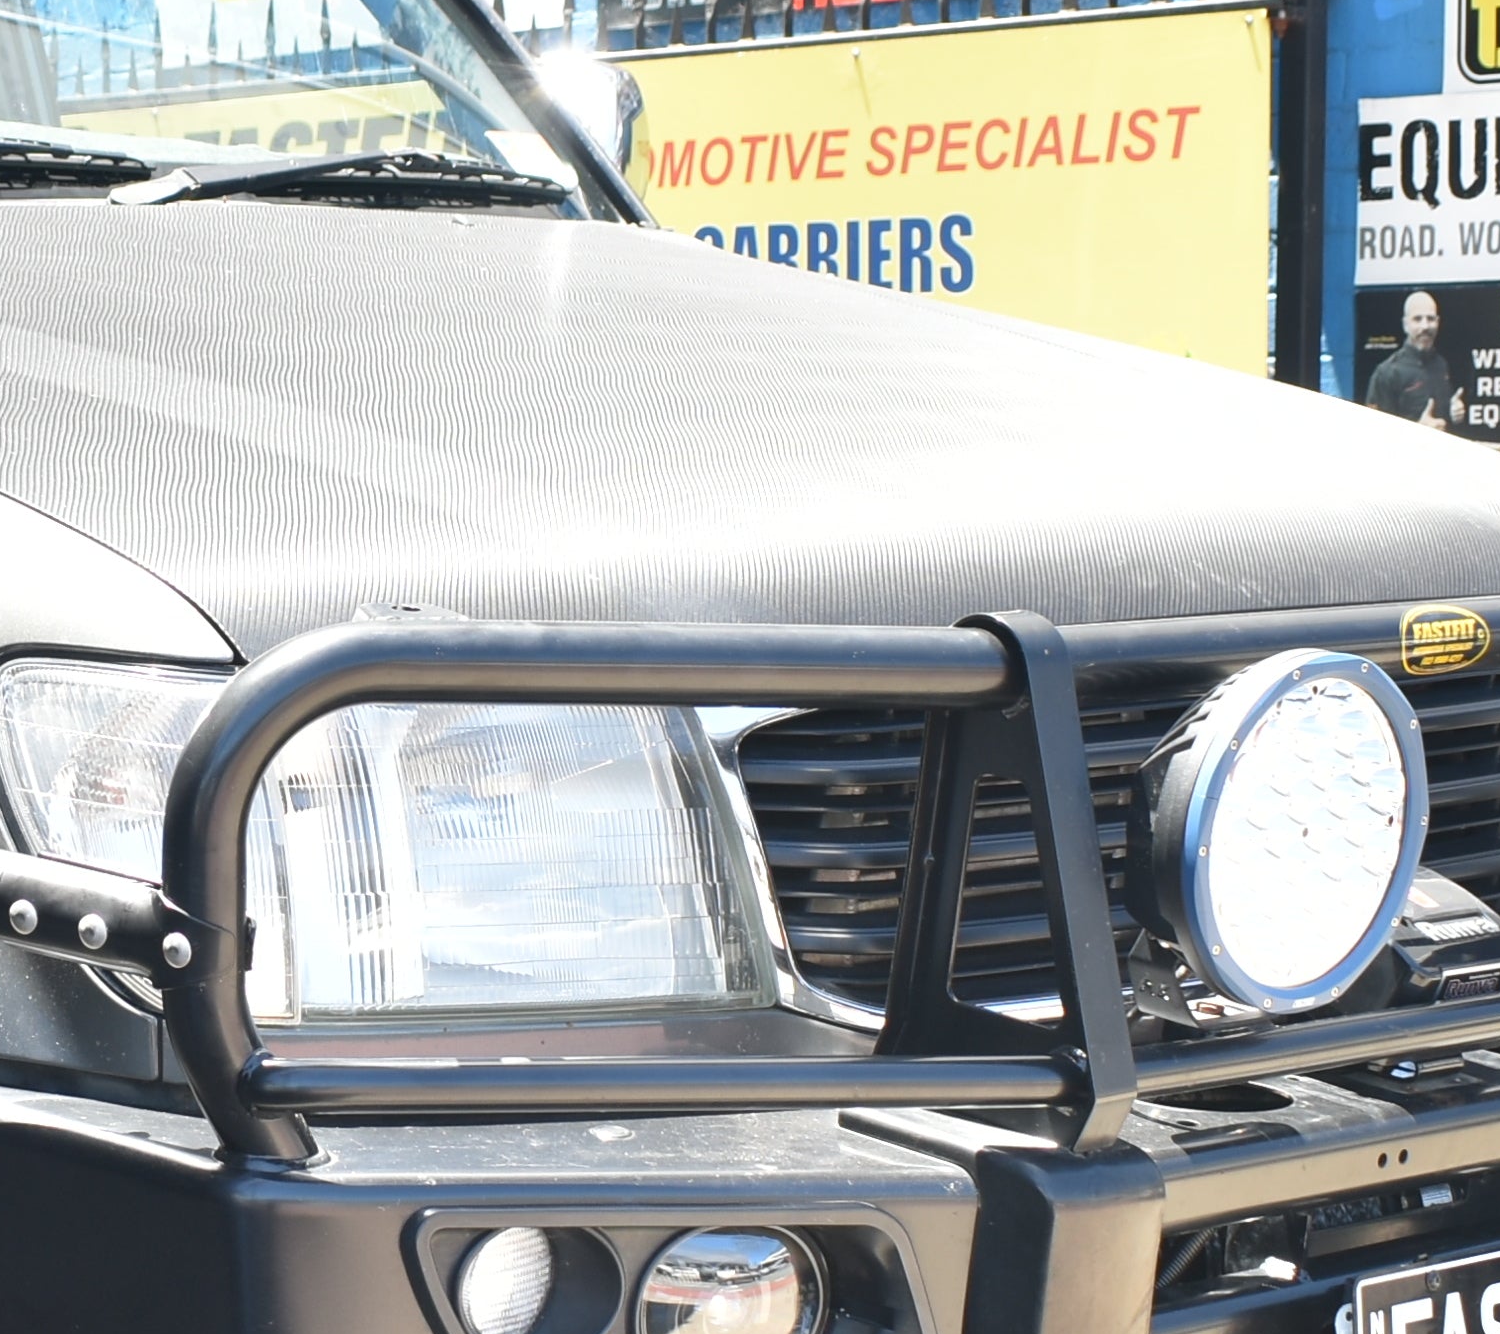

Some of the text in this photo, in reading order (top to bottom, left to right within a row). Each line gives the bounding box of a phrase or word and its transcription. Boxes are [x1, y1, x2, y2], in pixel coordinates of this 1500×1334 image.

[645, 105, 1201, 189] MOTIVE SPECIALIST
[1359, 223, 1445, 260] ROAD.
[1412, 618, 1477, 640] FASTFIT
